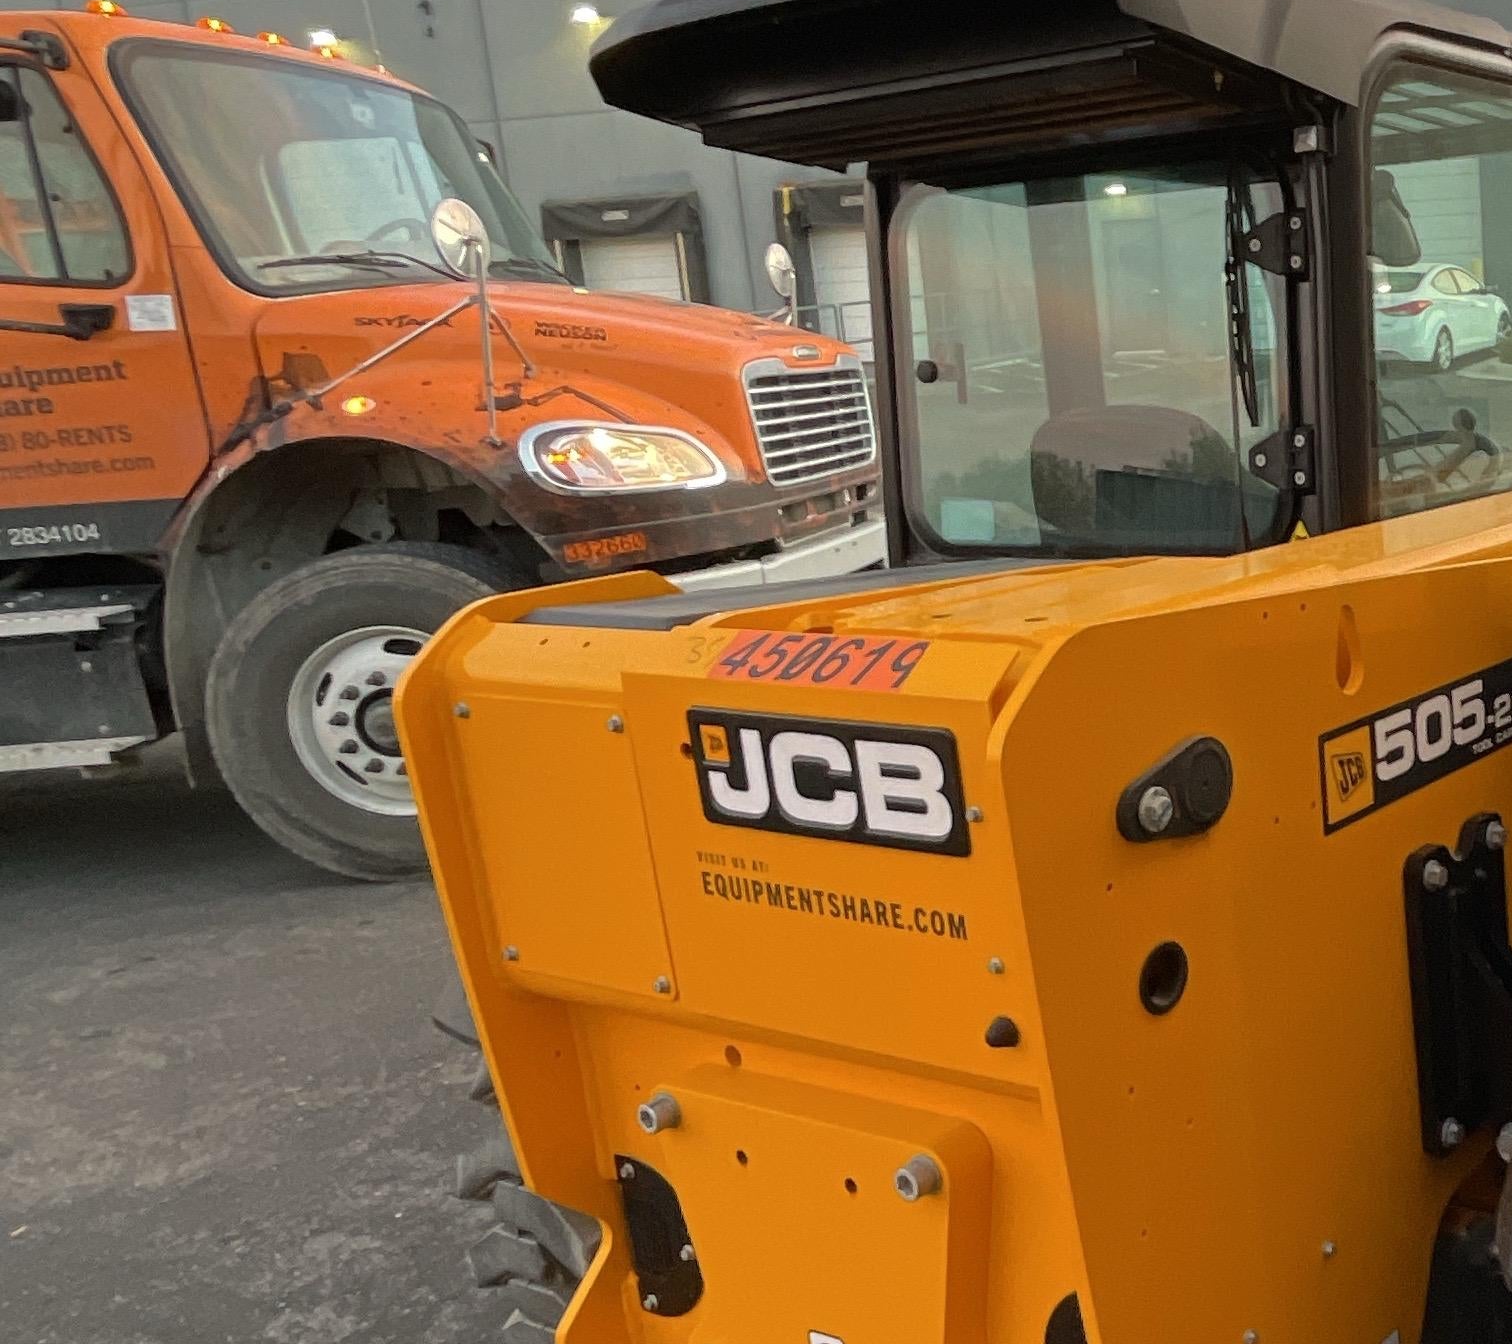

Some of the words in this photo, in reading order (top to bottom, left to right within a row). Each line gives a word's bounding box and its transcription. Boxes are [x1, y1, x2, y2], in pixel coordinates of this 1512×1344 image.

[22, 424, 132, 450] 80-RENTS
[7, 523, 101, 545] 2834104
[719, 632, 930, 689] 450619
[707, 727, 954, 842] JCB
[1337, 755, 1366, 796] JCB
[701, 870, 969, 941] EQUIPMENTSHARE.COM
